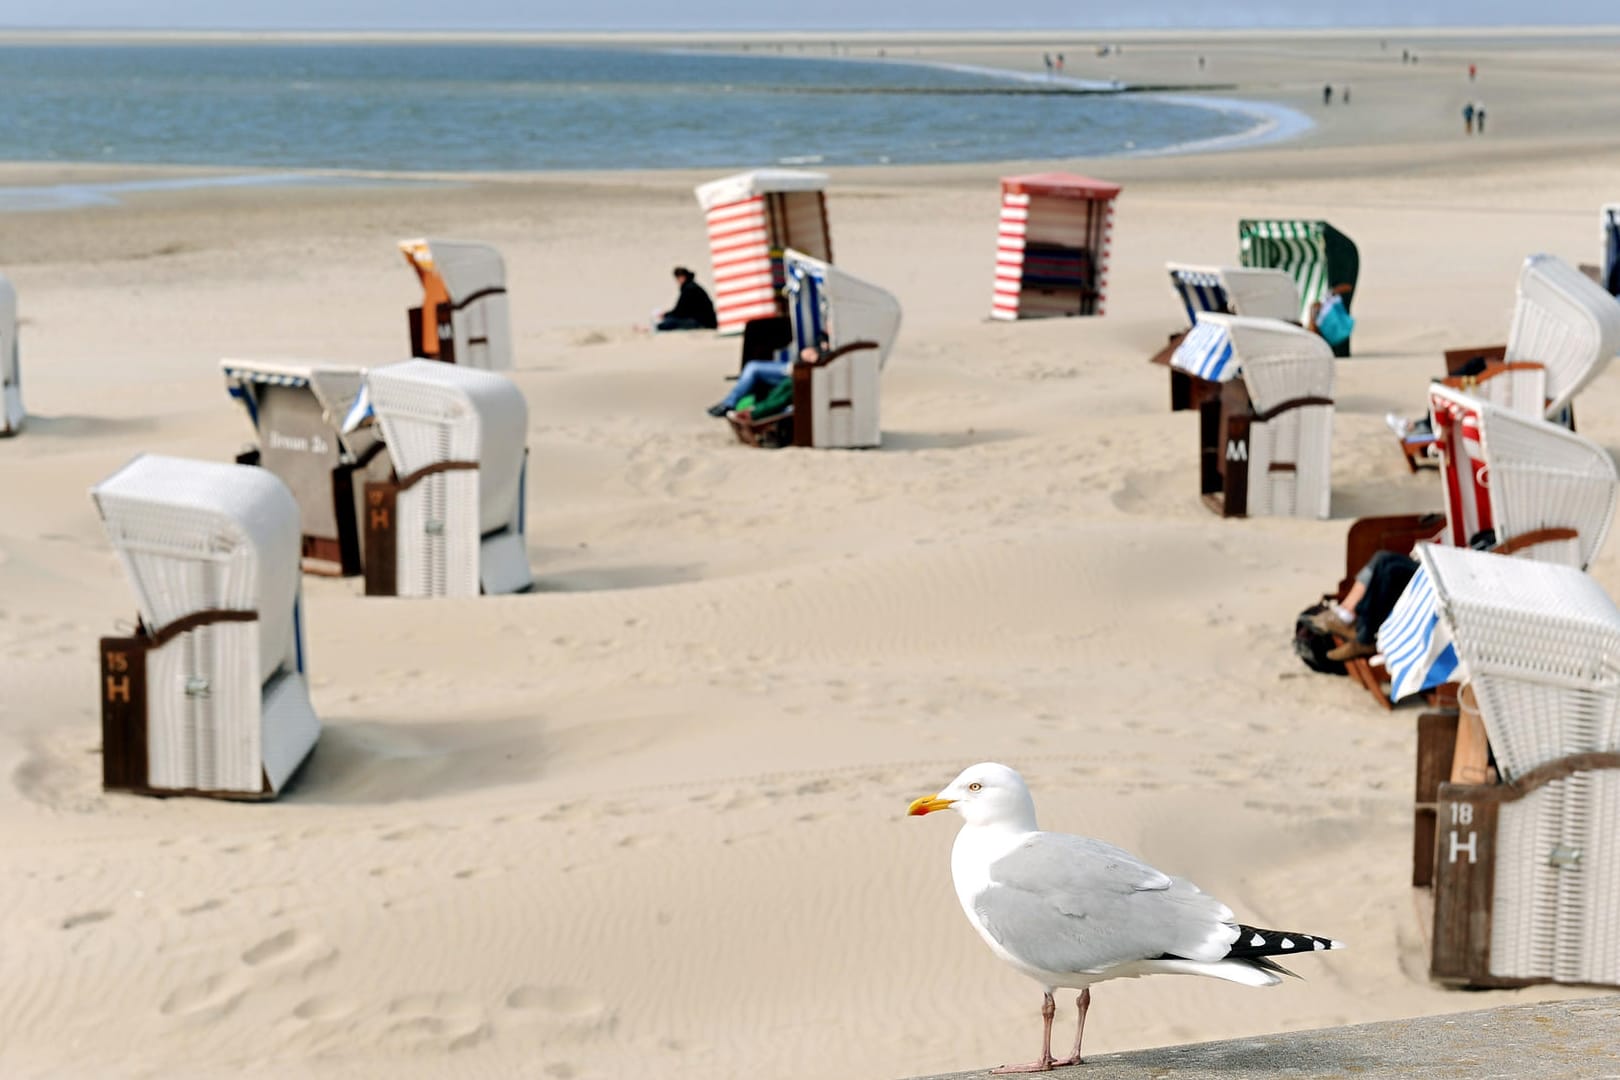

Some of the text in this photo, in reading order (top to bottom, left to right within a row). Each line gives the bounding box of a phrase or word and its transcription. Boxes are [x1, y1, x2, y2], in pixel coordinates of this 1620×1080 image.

[1226, 439, 1248, 461] M
[107, 676, 130, 702] H
[1450, 802, 1473, 825] 18
[1449, 831, 1477, 864] H
